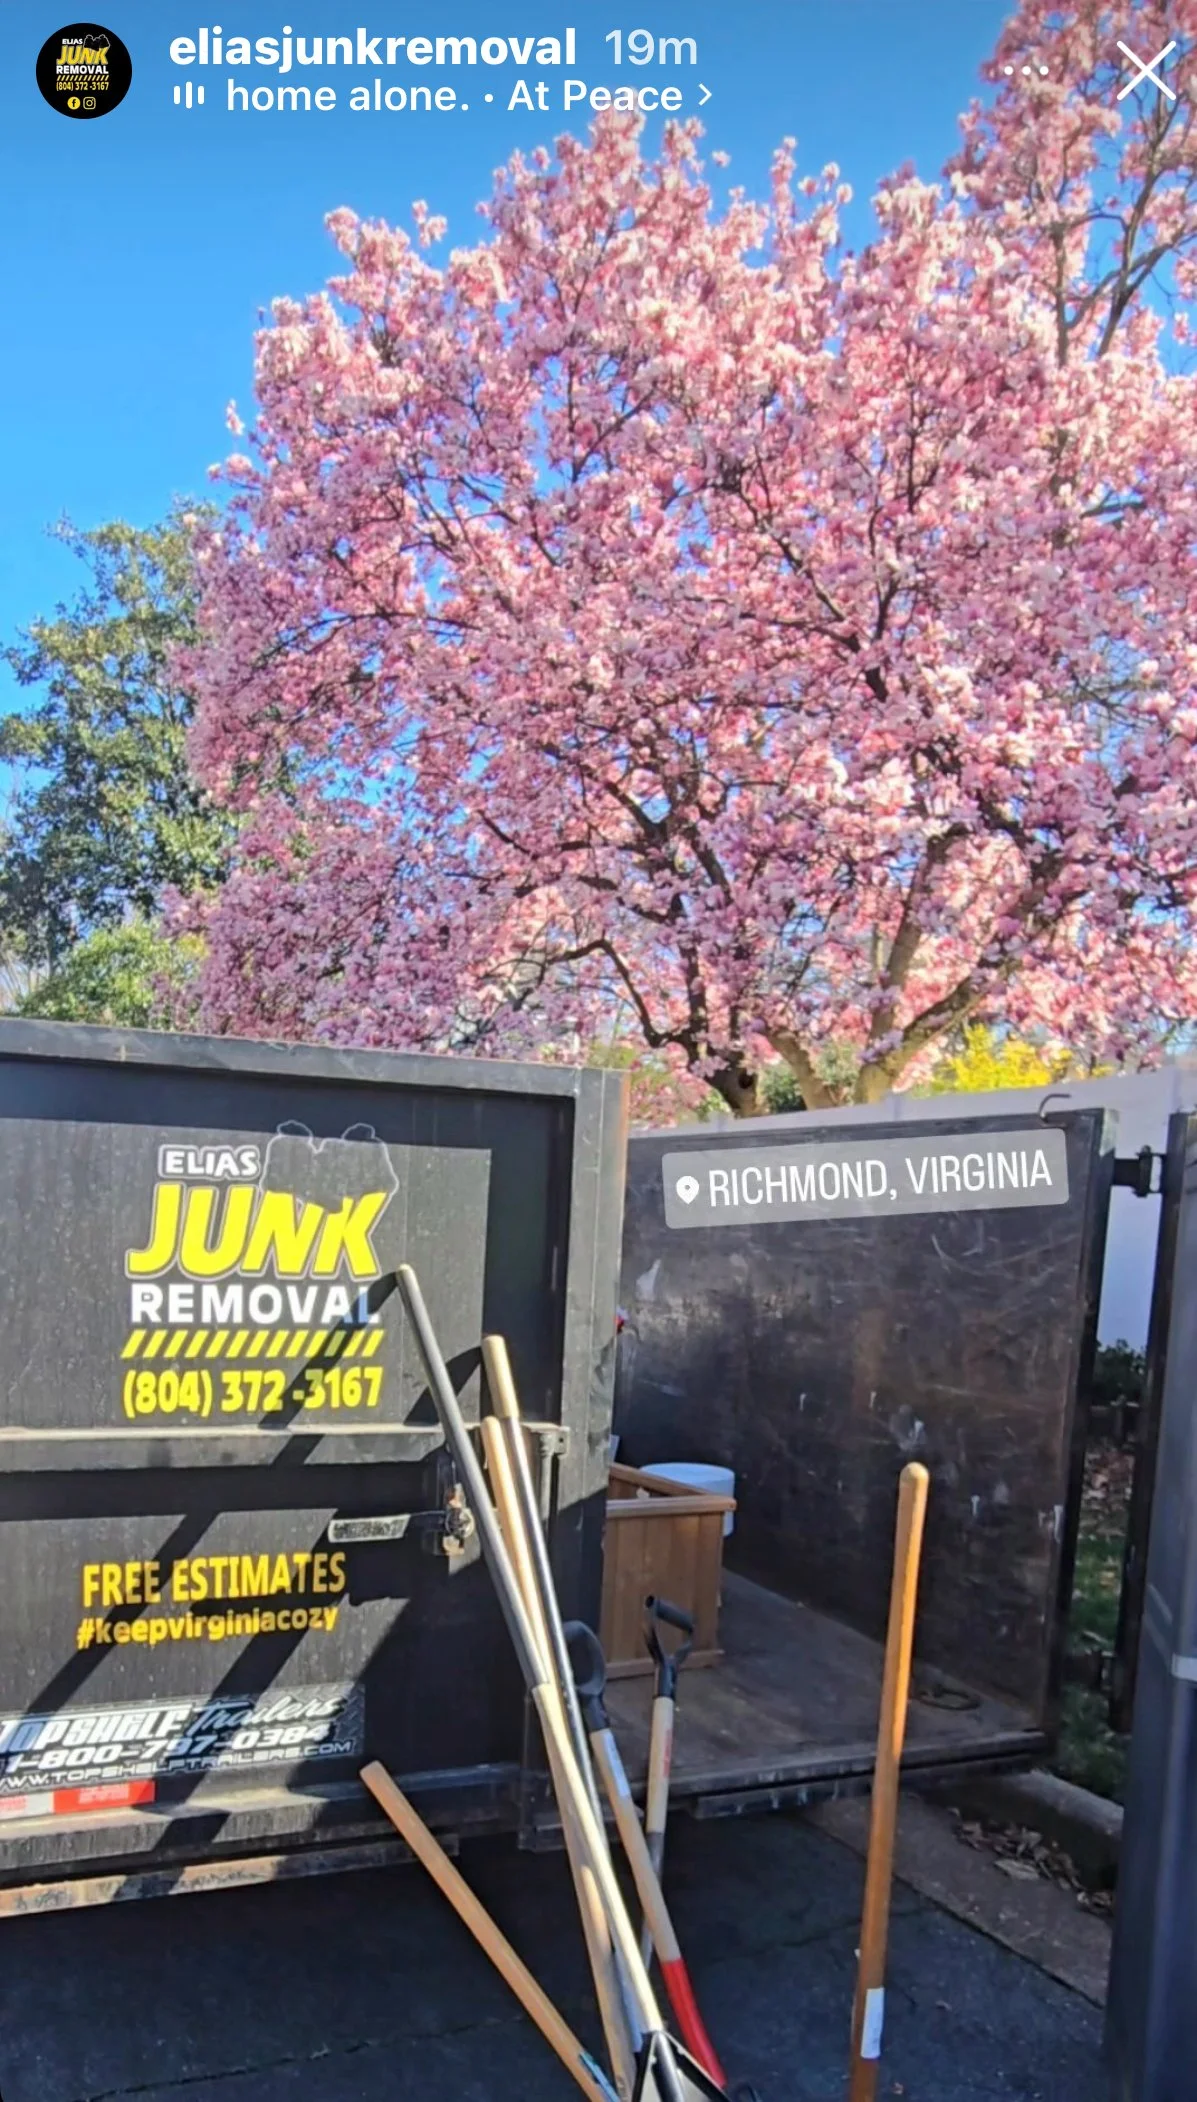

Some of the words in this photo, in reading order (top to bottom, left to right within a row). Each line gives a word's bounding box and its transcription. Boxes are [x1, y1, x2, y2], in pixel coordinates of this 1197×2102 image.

[163, 1149, 260, 1178] ELIAS
[127, 1183, 387, 1277] JUNK
[130, 1284, 379, 1324] REMOVAL
[123, 1369, 213, 1418] (804)
[220, 1369, 287, 1412] 372
[83, 1561, 161, 1608] FREE
[171, 1551, 346, 1601] ESTIMATES
[76, 1604, 339, 1649] #keepvirginiacozy
[5, 1723, 331, 1773] 1-800-797-0384
